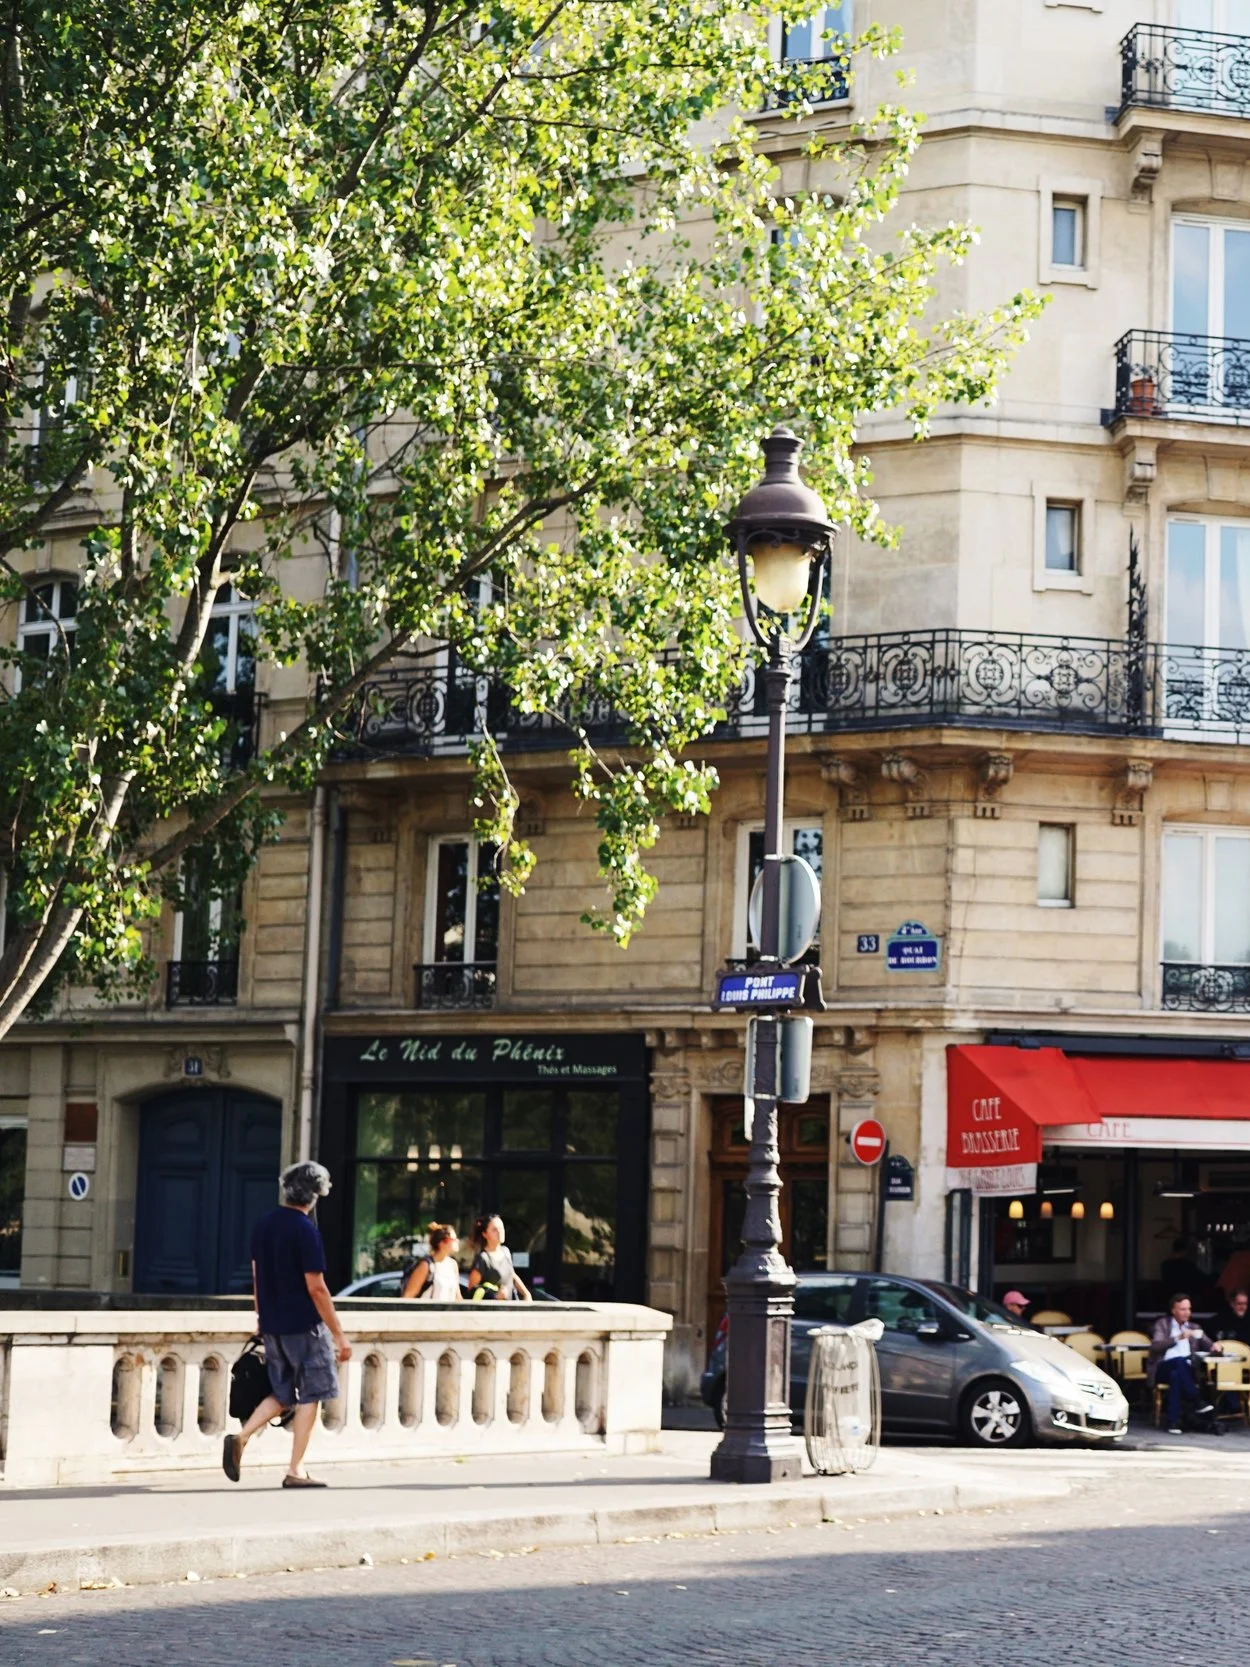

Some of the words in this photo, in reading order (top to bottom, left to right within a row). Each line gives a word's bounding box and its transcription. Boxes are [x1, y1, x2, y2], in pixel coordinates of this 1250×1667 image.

[860, 936, 877, 952] 33
[902, 946, 924, 955] QUAI
[900, 956, 937, 965] BOURBON
[744, 976, 775, 989] PONT
[720, 989, 749, 1002] LOUIS
[750, 987, 796, 1001] PHILIPPE
[360, 1039, 389, 1062] Le
[400, 1038, 442, 1062] Nid
[451, 1040, 478, 1062] du
[492, 1038, 565, 1062] Phénix
[560, 1065, 571, 1075] et
[572, 1064, 618, 1077] Massages
[971, 1097, 1002, 1122] CAFE
[1087, 1121, 1133, 1138] CAFE
[961, 1128, 1021, 1154] BRASSERIE
